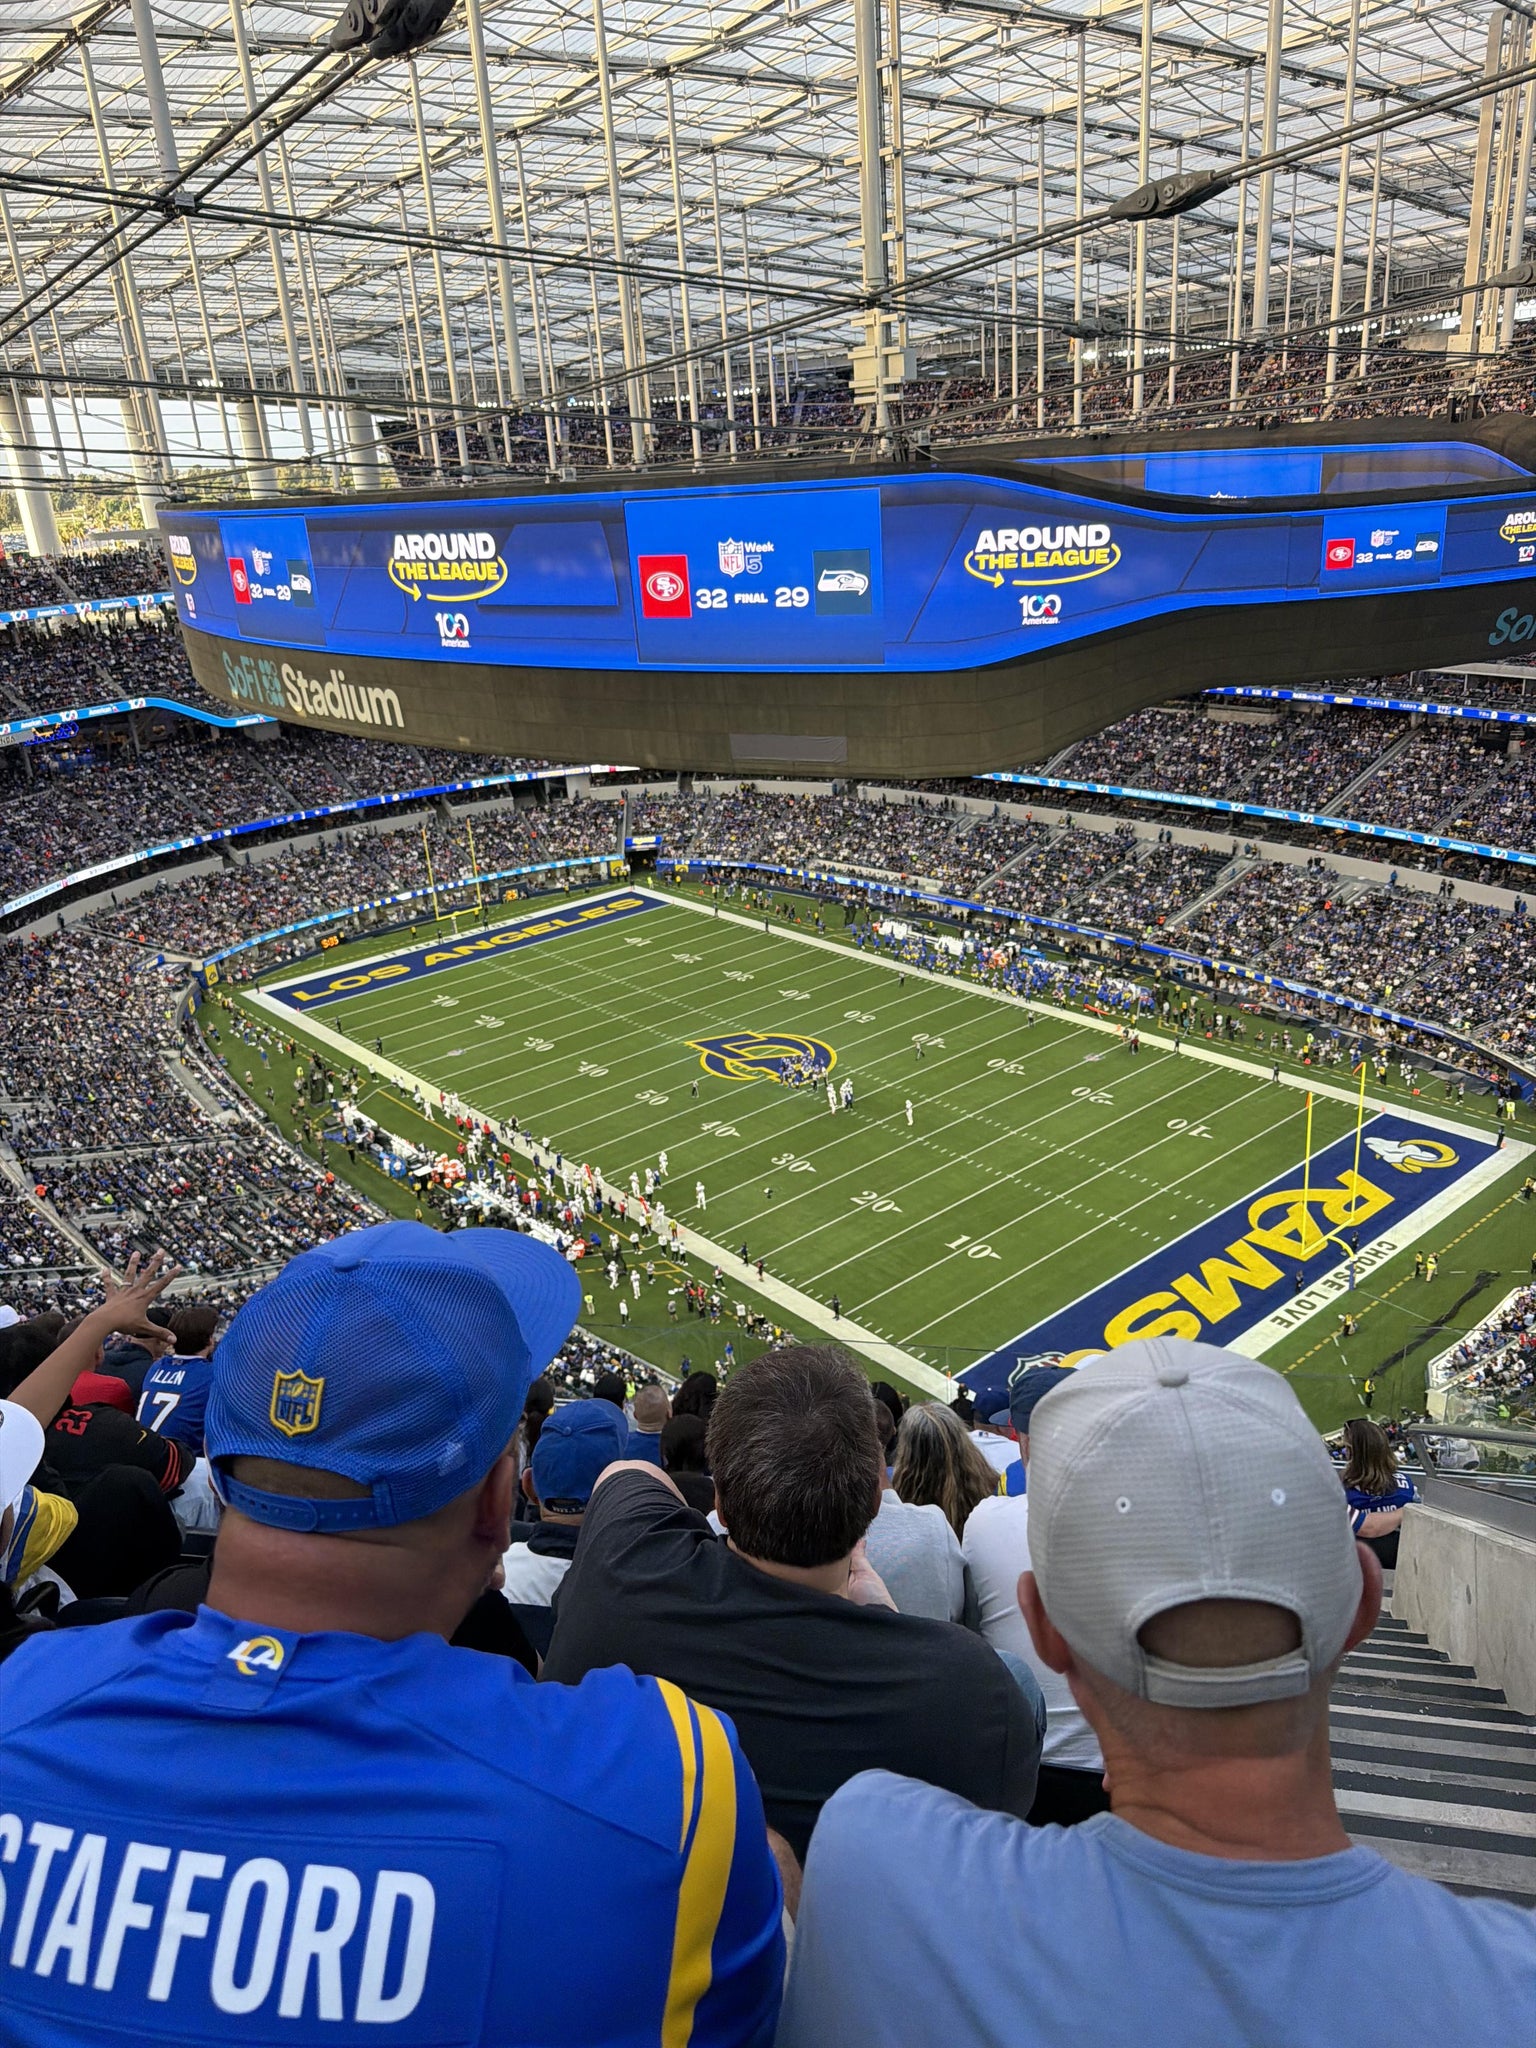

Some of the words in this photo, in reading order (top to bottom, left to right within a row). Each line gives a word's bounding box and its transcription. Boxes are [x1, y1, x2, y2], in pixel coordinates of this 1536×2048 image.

[394, 532, 496, 560] AROUND
[745, 541, 775, 553] Week
[975, 524, 1111, 553] AROUND
[745, 554, 764, 575] 5
[974, 552, 1019, 571] THE
[1021, 548, 1111, 568] LEAGUE
[1355, 553, 1373, 563] 32
[395, 561, 428, 581] THE
[428, 561, 500, 581] LEAGUE
[250, 584, 263, 599] 32
[276, 585, 291, 601] 29
[696, 588, 728, 610] 32
[734, 592, 769, 604] FINAL
[774, 587, 810, 608] 29
[1019, 594, 1062, 617] 100
[434, 612, 470, 639] 100
[1022, 616, 1061, 626] American
[441, 638, 471, 648] American
[222, 650, 264, 704] SoFi
[281, 663, 405, 738] Stadium
[292, 963, 412, 1002] LOS
[424, 897, 646, 967] ANGELES
[843, 1010, 877, 1024] 50
[634, 1088, 670, 1106] 50
[700, 1120, 737, 1138] 40
[770, 1152, 811, 1173] 30
[849, 1190, 896, 1213] 20
[944, 1234, 993, 1260] 10
[1104, 1168, 1396, 1350] RAMS
[1269, 1289, 1330, 1330] LOVE
[150, 1368, 186, 1385] ALLEN
[54, 1408, 93, 1436] 23
[135, 1390, 181, 1433] 17
[276, 1397, 313, 1426] NFL
